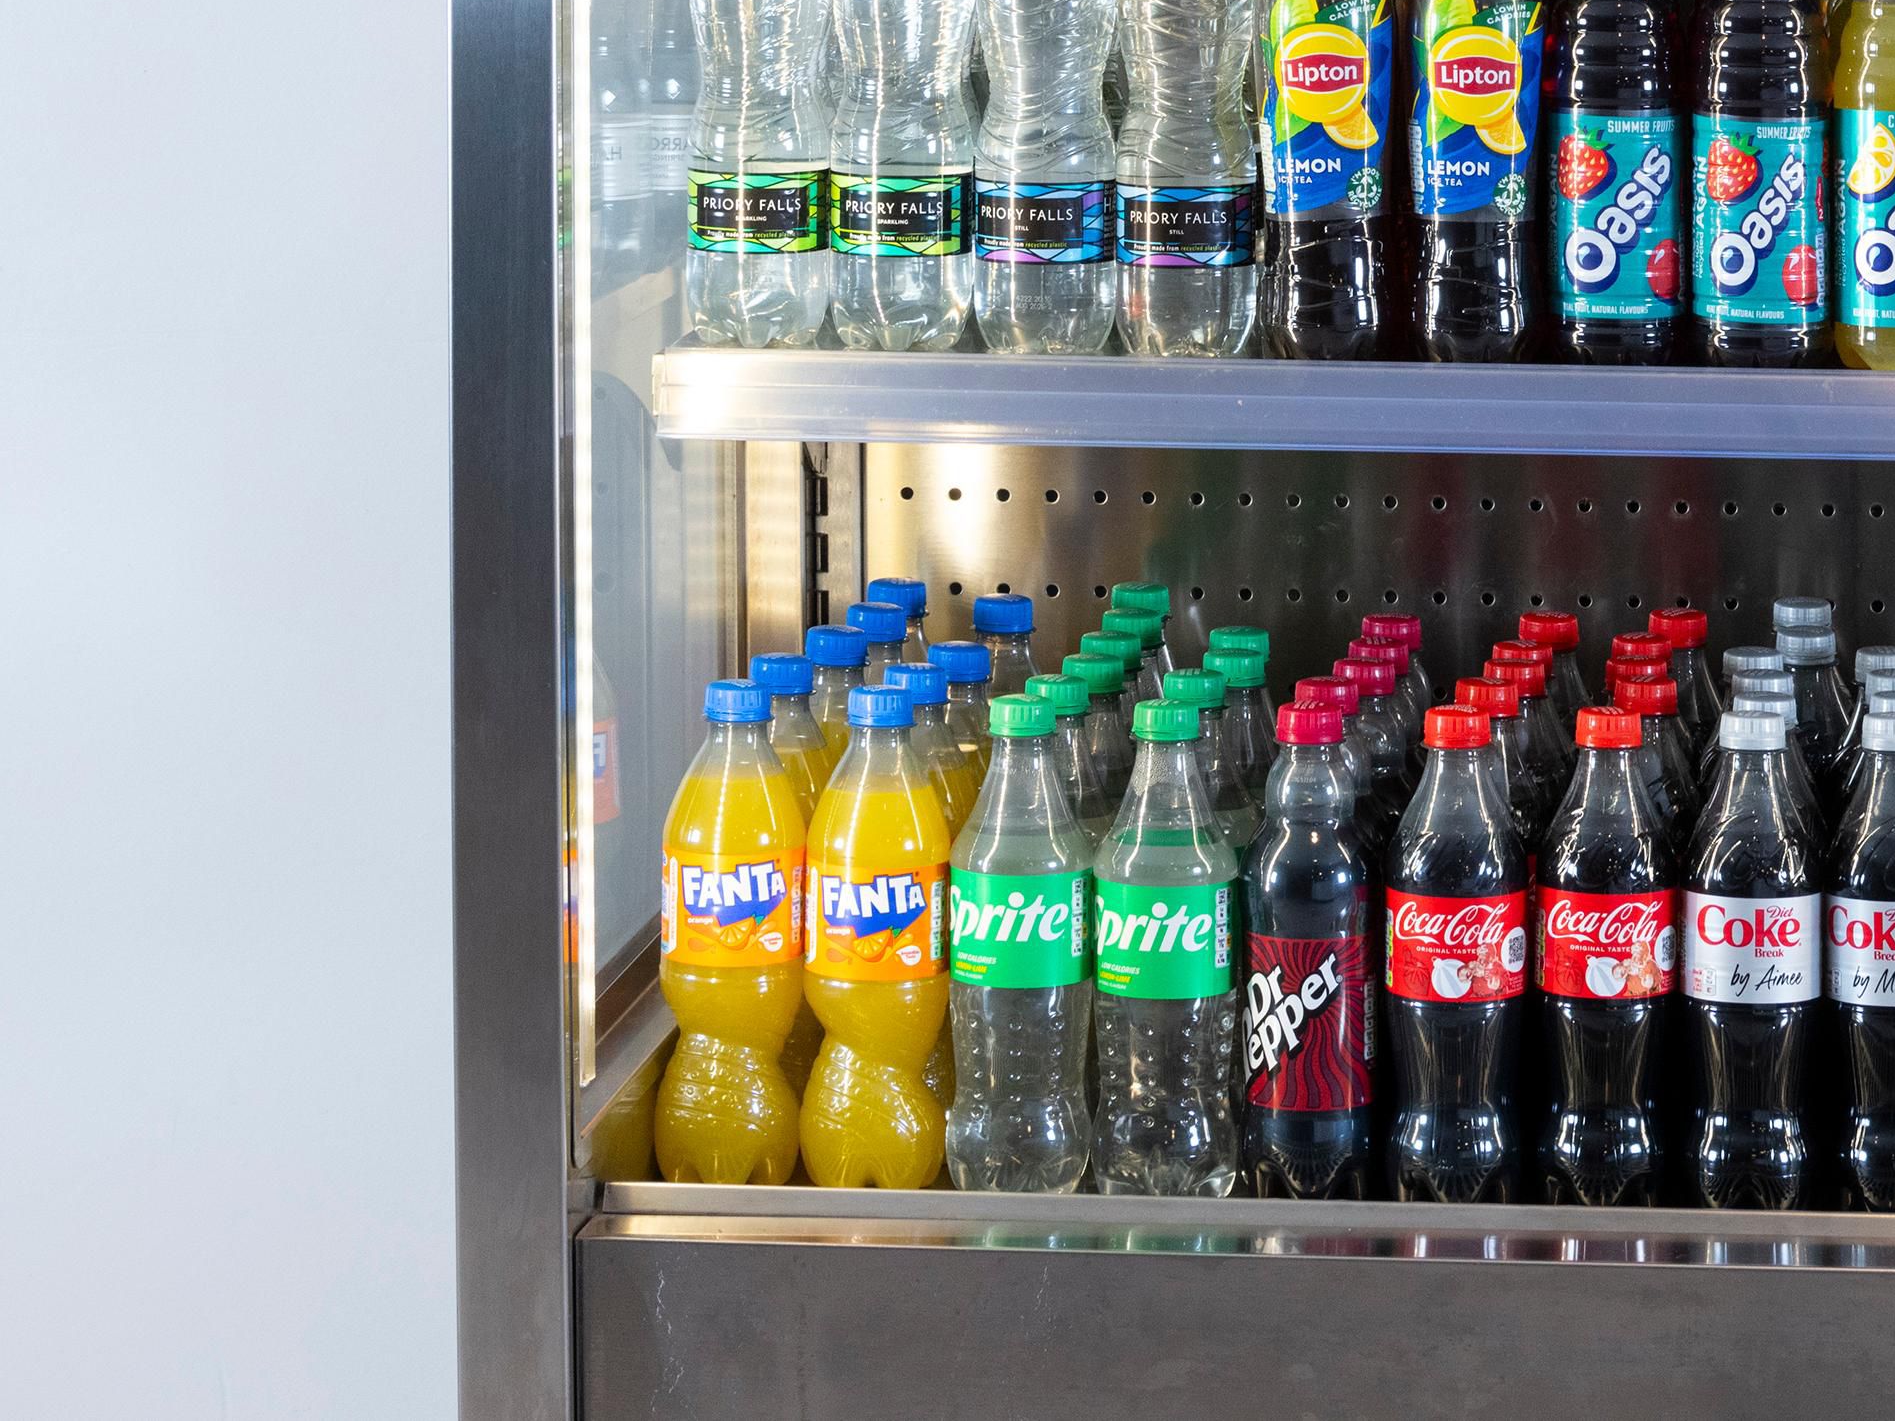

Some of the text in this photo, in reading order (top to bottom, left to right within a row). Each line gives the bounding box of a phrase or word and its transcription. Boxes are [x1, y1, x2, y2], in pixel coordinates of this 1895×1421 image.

[1287, 63, 1358, 85] Lipton
[1440, 65, 1511, 88] Lipton
[1607, 119, 1651, 134] SUMMER
[1276, 158, 1341, 174] LEMON
[1427, 160, 1490, 176] LEMON
[845, 200, 944, 215] PRIORY FALLS
[981, 205, 1074, 221] PRIORY FALLS
[1129, 210, 1228, 225] PRIORY FALLS
[1565, 147, 1672, 283] Oasis
[683, 862, 786, 908] FANTA
[822, 875, 926, 918] FANTA
[1395, 899, 1511, 946] Coca-Cola
[1547, 898, 1663, 945] Coca-Cola
[1767, 905, 1794, 919] Diet
[1697, 904, 1801, 948] Coke
[1416, 945, 1451, 955] ORIGINAL
[1754, 948, 1785, 959] Break
[1730, 963, 1803, 997] by Aimee
[1852, 965, 1871, 1000] by
[1247, 965, 1284, 1029] Dr
